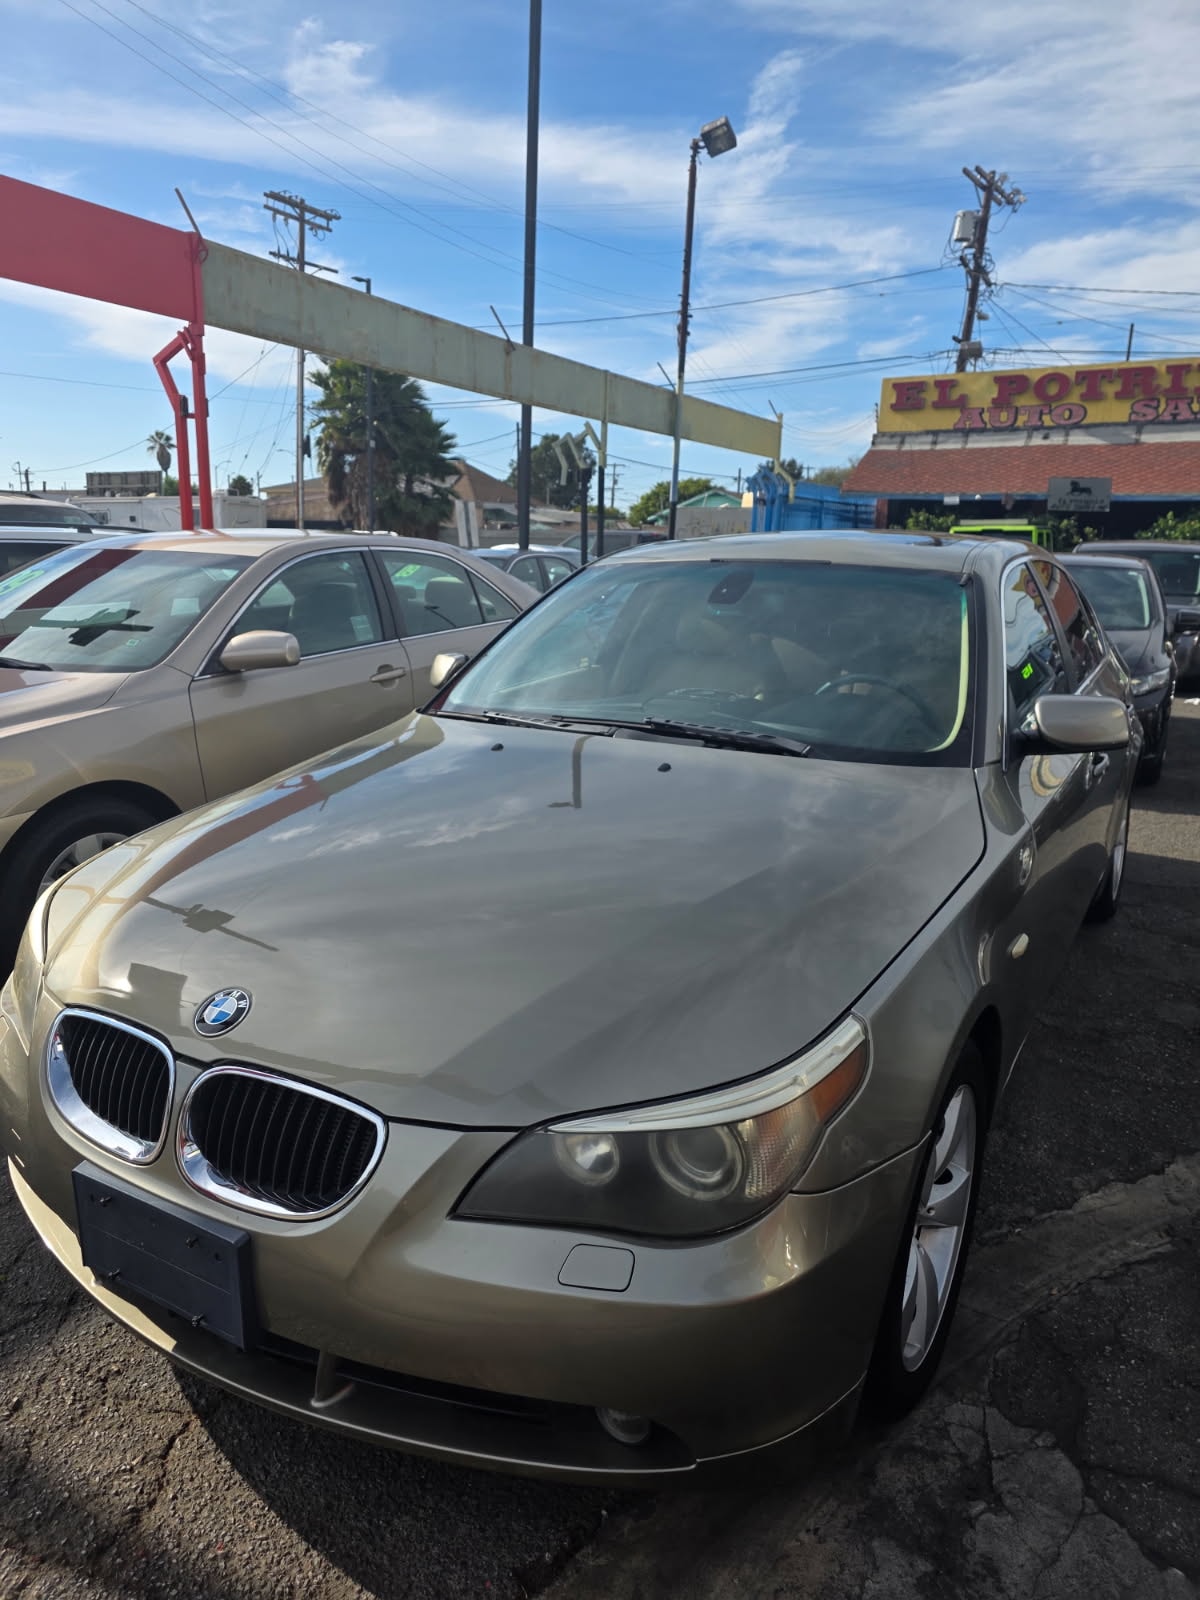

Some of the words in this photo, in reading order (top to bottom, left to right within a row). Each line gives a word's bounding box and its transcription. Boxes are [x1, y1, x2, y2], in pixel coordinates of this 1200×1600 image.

[890, 379, 968, 411] EL
[954, 402, 1087, 429] AUTO
[1128, 397, 1200, 422] SA
